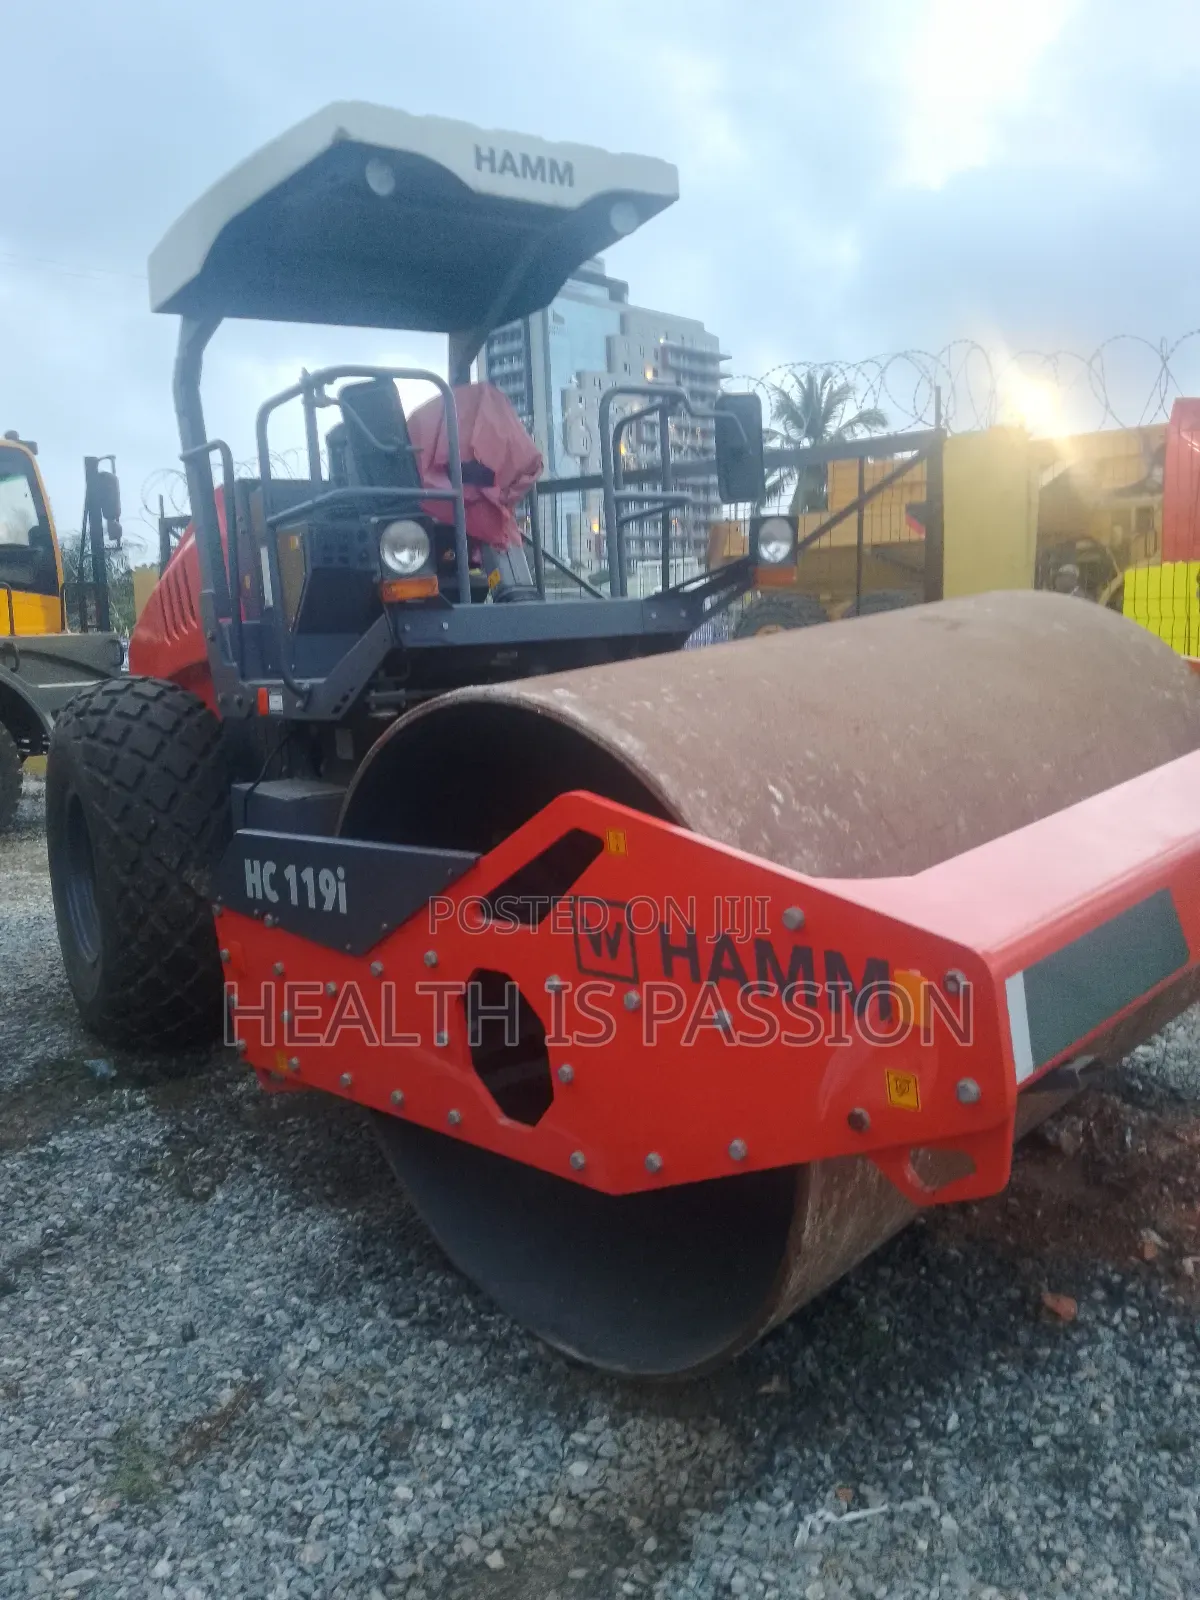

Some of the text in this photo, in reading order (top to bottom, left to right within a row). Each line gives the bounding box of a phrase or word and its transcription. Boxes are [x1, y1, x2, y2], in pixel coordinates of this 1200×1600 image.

[474, 143, 575, 188] HAMM
[244, 858, 347, 914] HC 119i
[658, 922, 893, 1023] HAMM
